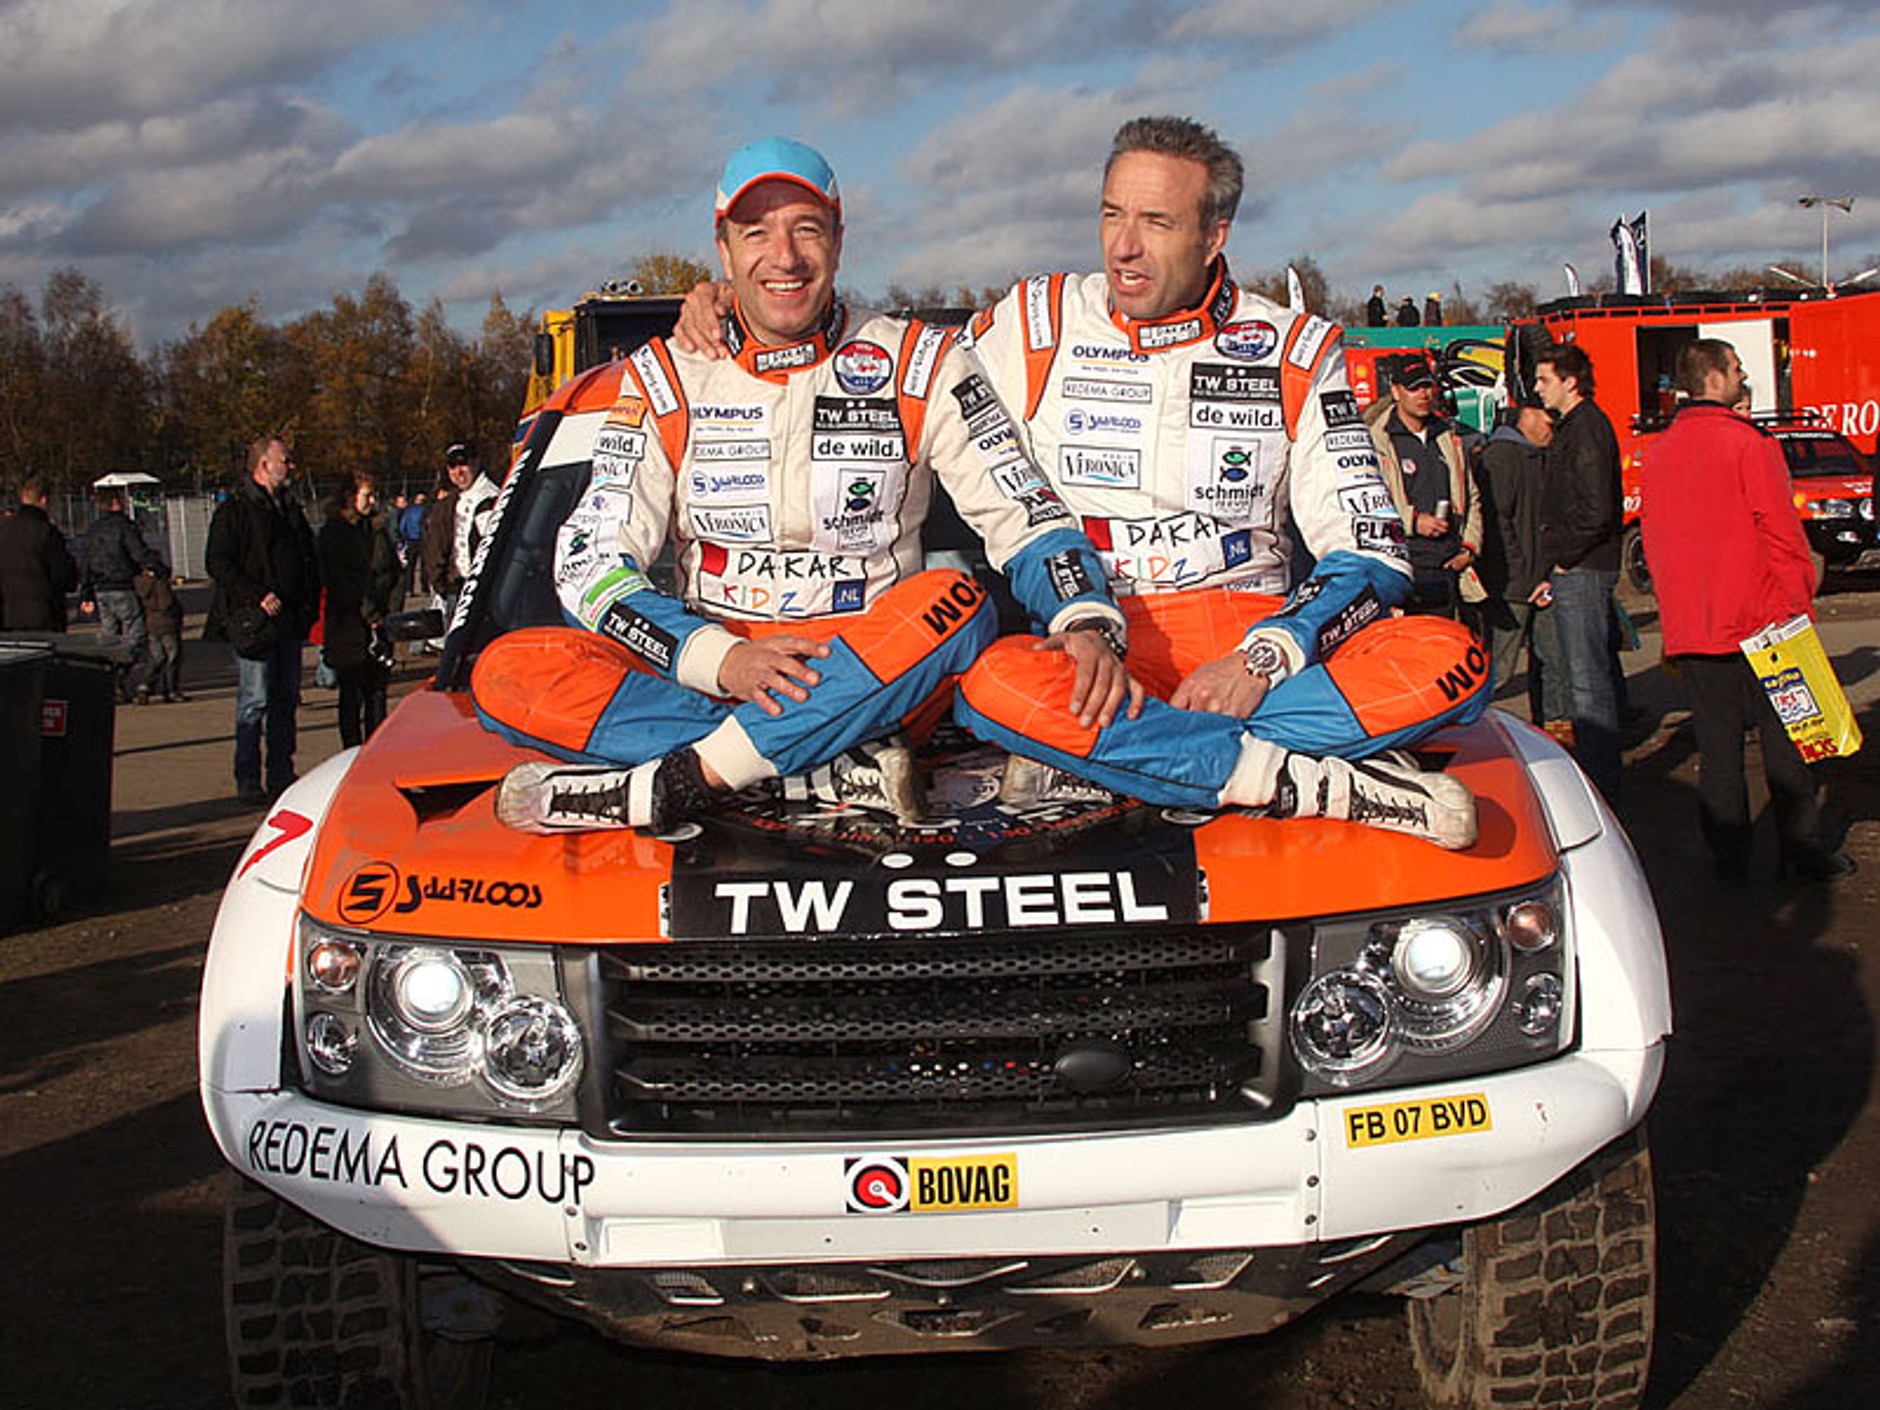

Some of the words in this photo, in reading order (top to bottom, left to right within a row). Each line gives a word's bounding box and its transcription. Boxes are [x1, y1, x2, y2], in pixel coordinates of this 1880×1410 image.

[1194, 375, 1221, 390] TW
[1226, 377, 1279, 391] STEEL
[817, 408, 841, 422] TW
[847, 408, 899, 423] STEEL
[1196, 405, 1223, 424] de
[1229, 408, 1280, 427] wild.
[817, 439, 845, 455] de
[850, 438, 900, 457] wild.
[1194, 483, 1265, 500] schmidt
[738, 552, 851, 580] DAKAR
[1114, 556, 1199, 582] KIDZ
[723, 585, 806, 613] KIDZ
[608, 611, 631, 634] TW
[627, 626, 669, 661] STEEL
[715, 881, 854, 934] TW
[887, 871, 1169, 932] STEEL
[1349, 1111, 1386, 1141] FB
[1394, 1106, 1421, 1136] 07
[1431, 1099, 1487, 1131] BVD
[249, 1120, 408, 1189] REDEMA
[422, 1138, 595, 1205] GROUP
[918, 1163, 1010, 1205] BOVAG
